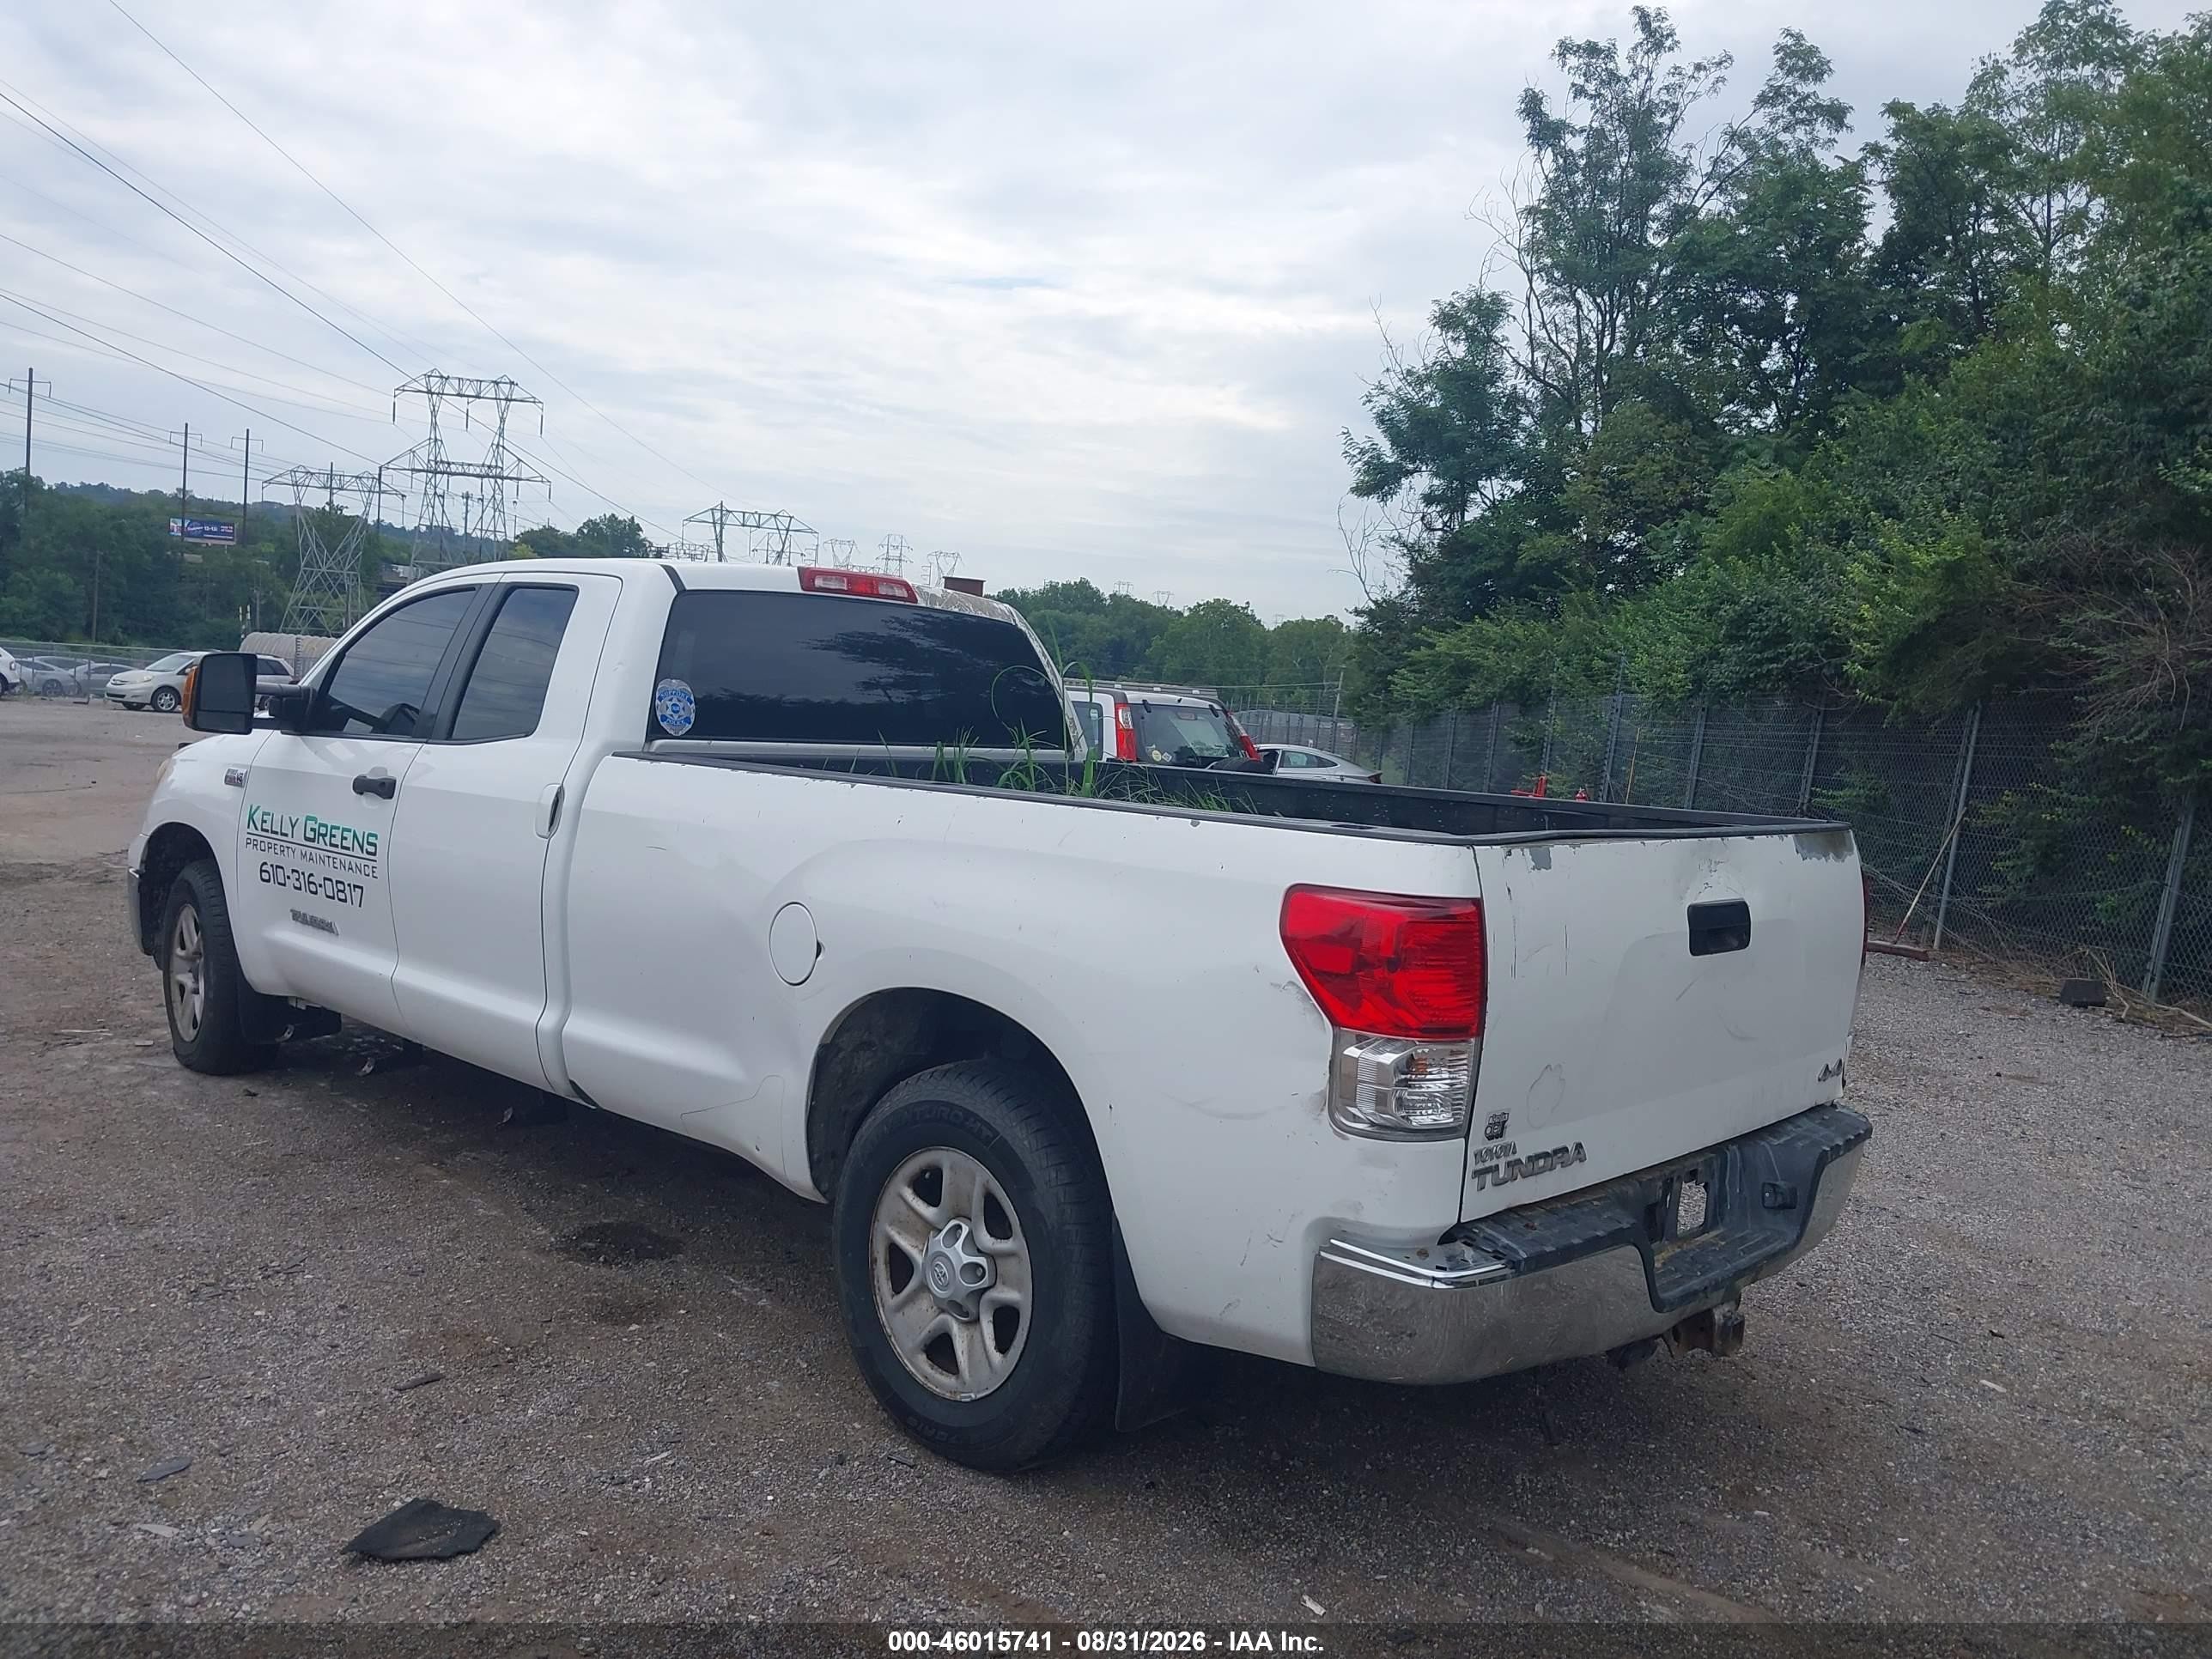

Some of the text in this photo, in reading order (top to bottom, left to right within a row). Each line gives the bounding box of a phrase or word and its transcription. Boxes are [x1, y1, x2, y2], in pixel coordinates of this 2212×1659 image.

[246, 804, 379, 857] KELLY GREENS
[246, 837, 379, 879] PROPERTY MAINTENANCE
[259, 861, 364, 908] 610-316-0817
[1471, 1141, 1587, 1191] TUNDRA
[1474, 1141, 1517, 1165] TOYOTA
